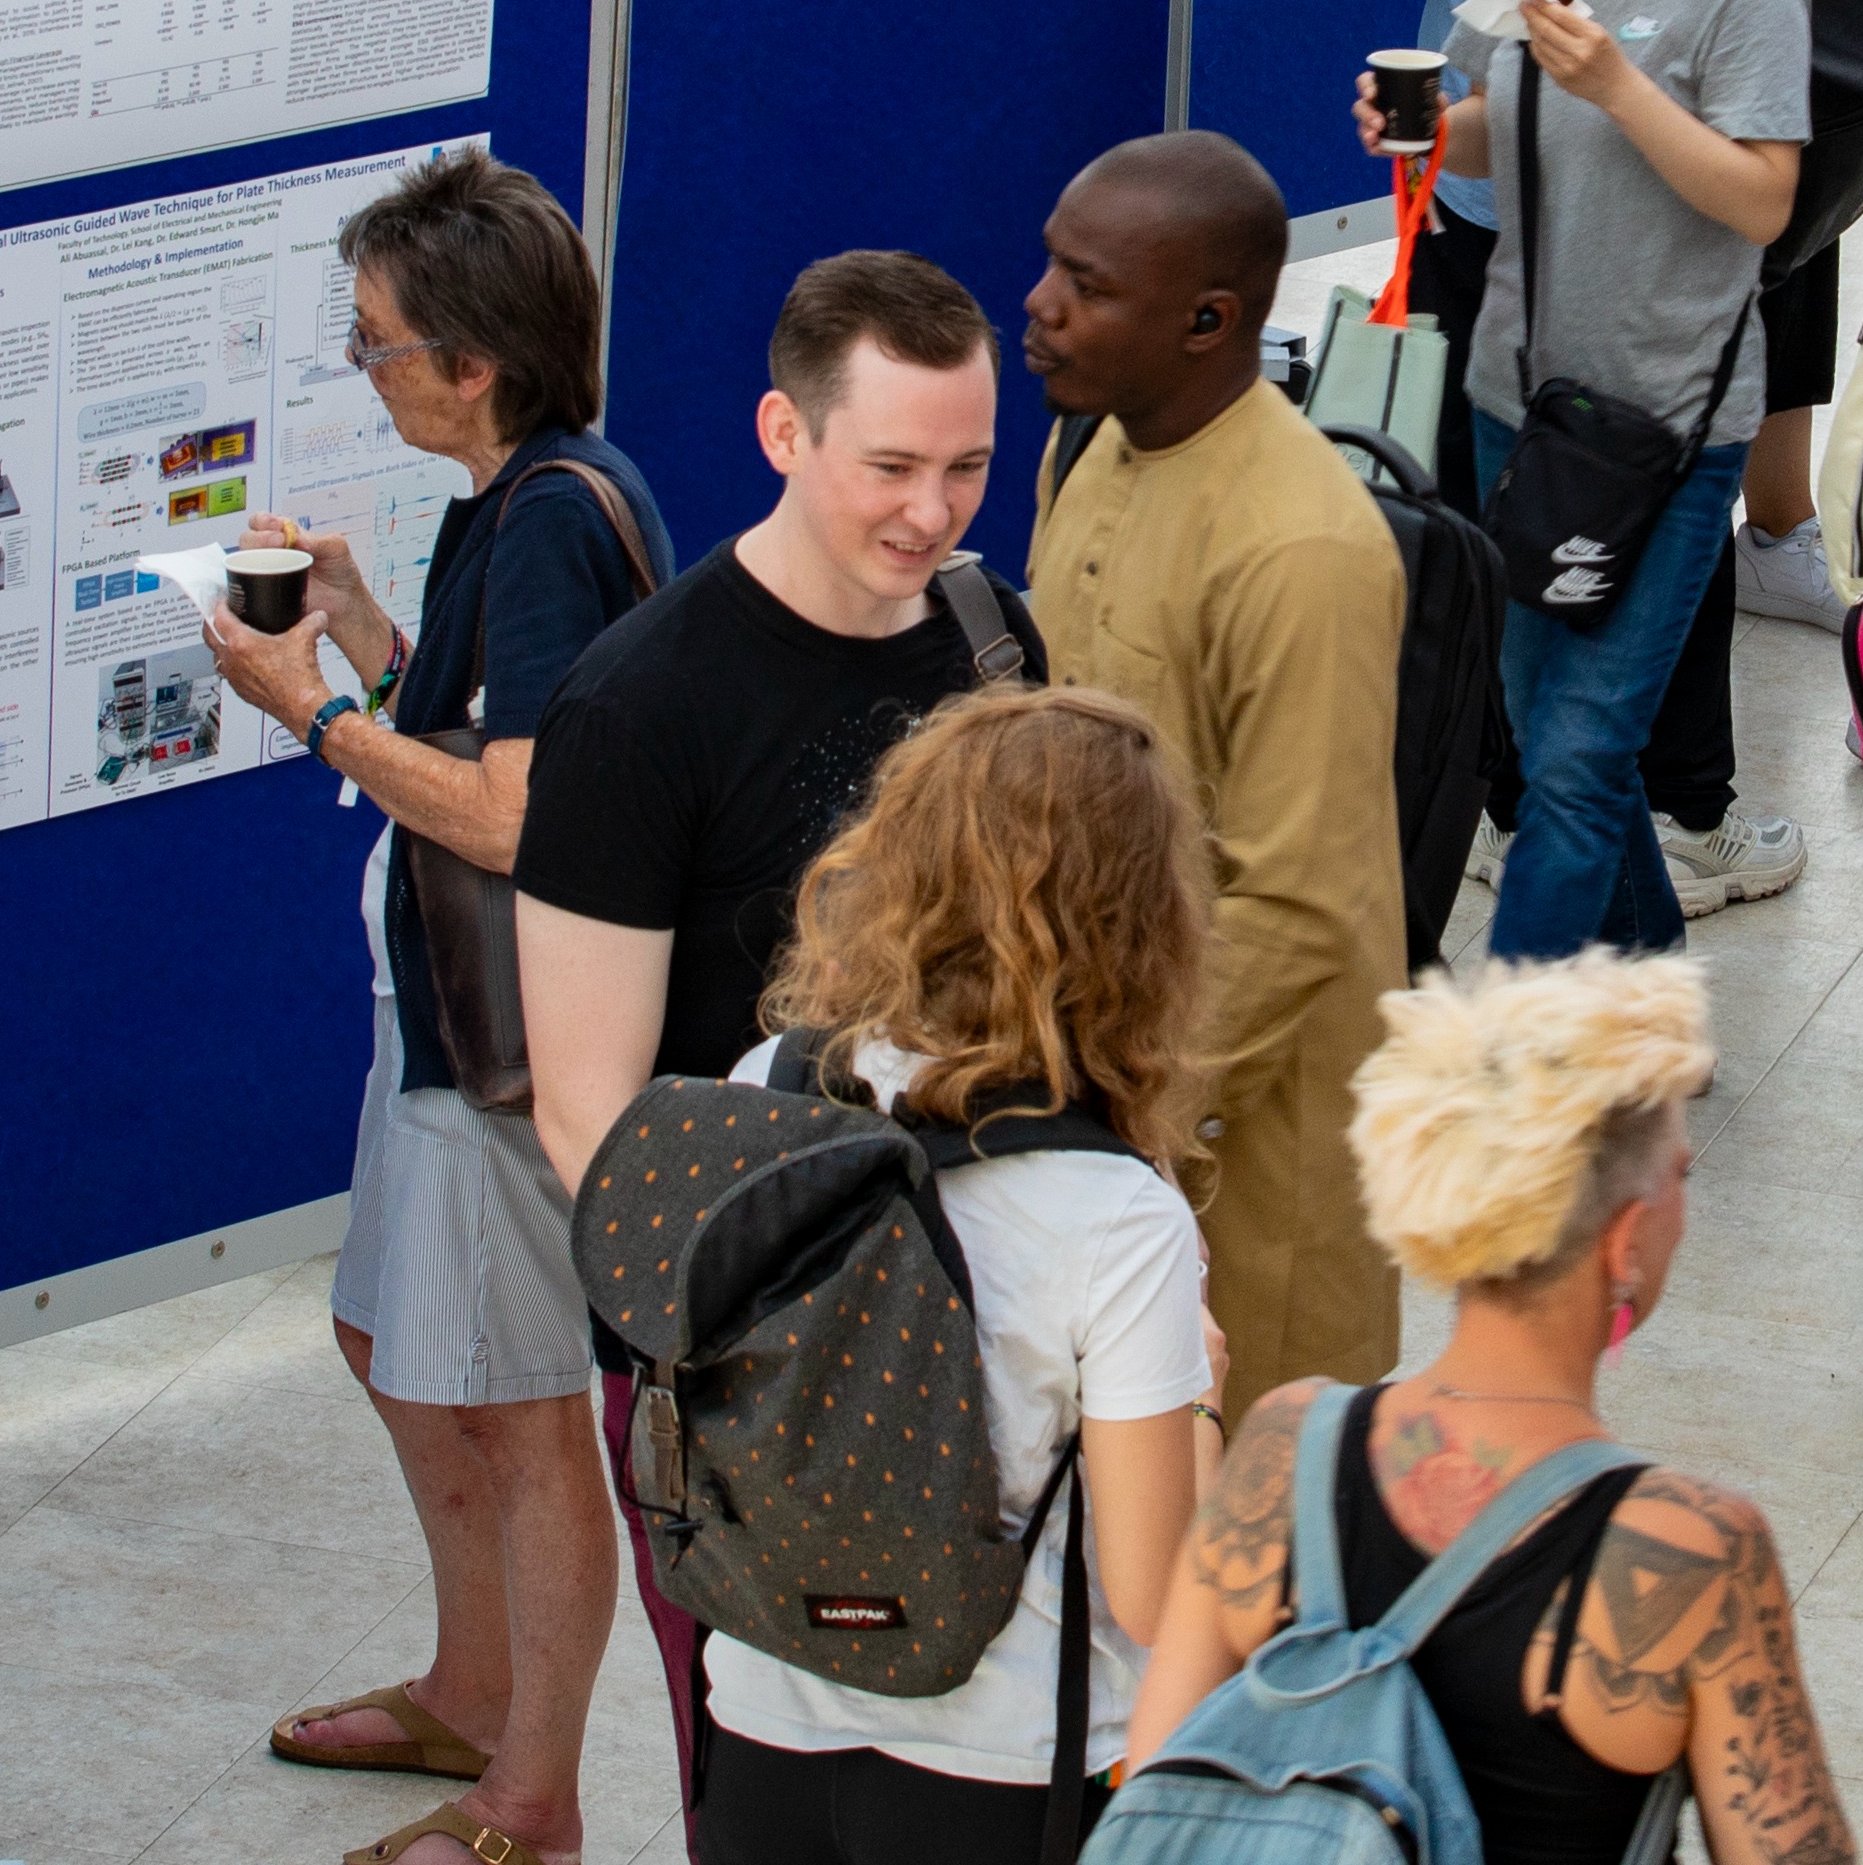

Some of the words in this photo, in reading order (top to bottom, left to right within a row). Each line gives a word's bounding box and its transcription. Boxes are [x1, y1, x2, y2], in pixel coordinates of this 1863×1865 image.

[9, 222, 71, 246] Ultrasonic
[73, 212, 116, 233] Guided
[118, 207, 151, 224] Wave
[152, 195, 215, 216] Technique
[216, 189, 234, 204] for
[235, 184, 265, 200] Plate
[266, 172, 322, 193] Thickness
[324, 155, 408, 182] Measurement
[819, 1607, 888, 1622] EASTPAK
